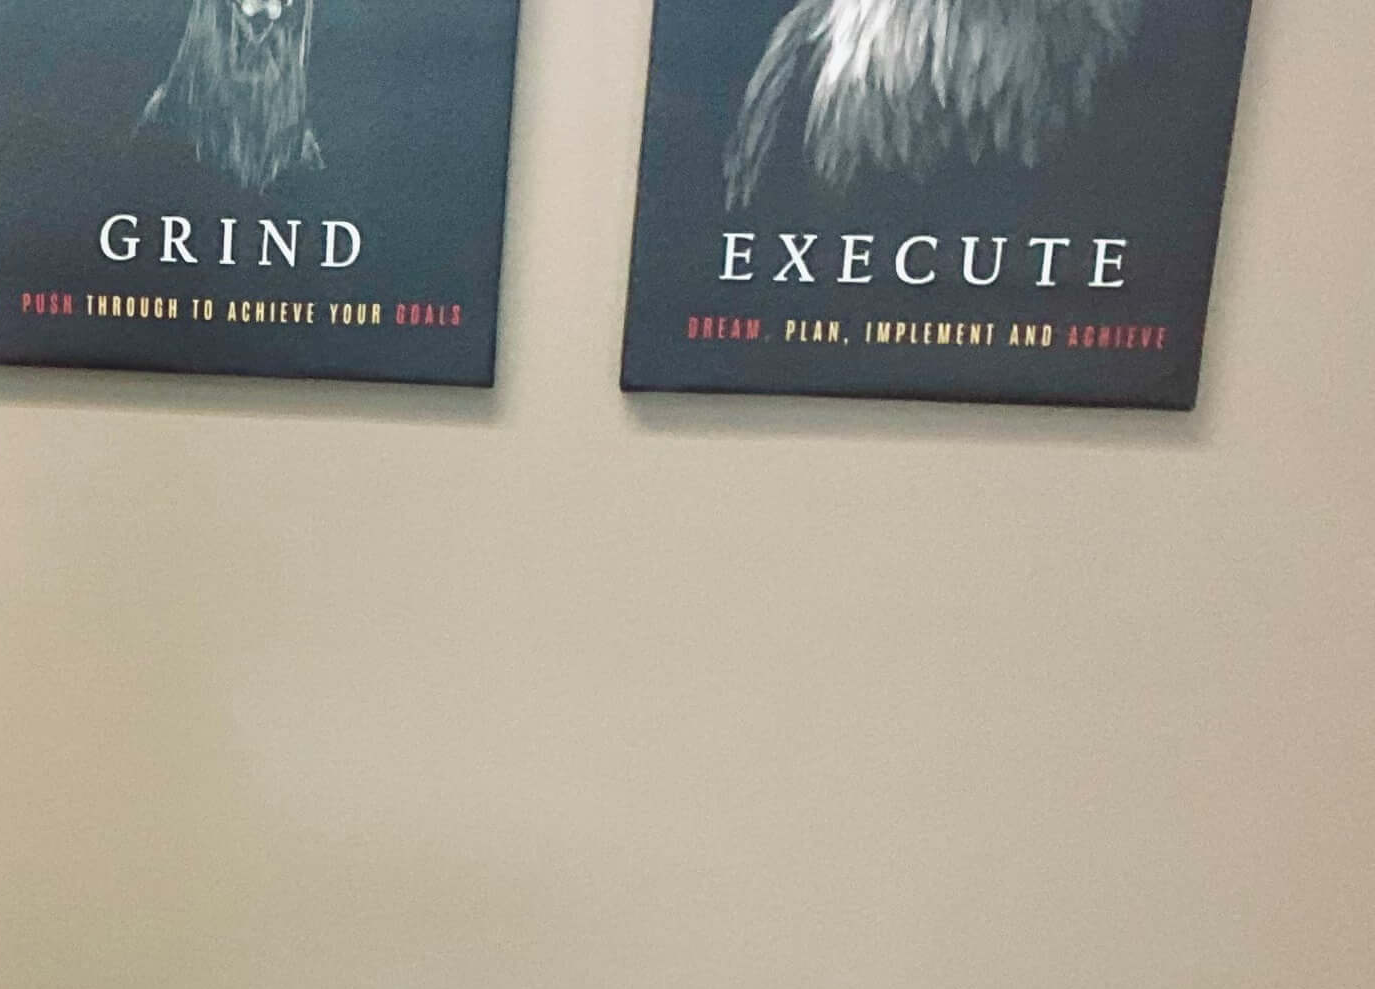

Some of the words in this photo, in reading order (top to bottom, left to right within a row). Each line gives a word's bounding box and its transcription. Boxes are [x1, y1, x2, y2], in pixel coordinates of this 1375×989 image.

[99, 213, 362, 268] GRIND
[718, 232, 1127, 287] EXECUTE
[21, 292, 73, 316] PUSH
[86, 294, 178, 319] THROUGH
[192, 299, 213, 321] TO
[227, 300, 315, 324] ACHIEVE
[329, 303, 381, 325] YOUR
[396, 303, 462, 326] GOALS
[785, 319, 849, 346] PLAN,
[865, 320, 995, 346] IMPLEMENT
[1009, 323, 1053, 347] AND
[1068, 325, 1167, 349] ACHIEVE
